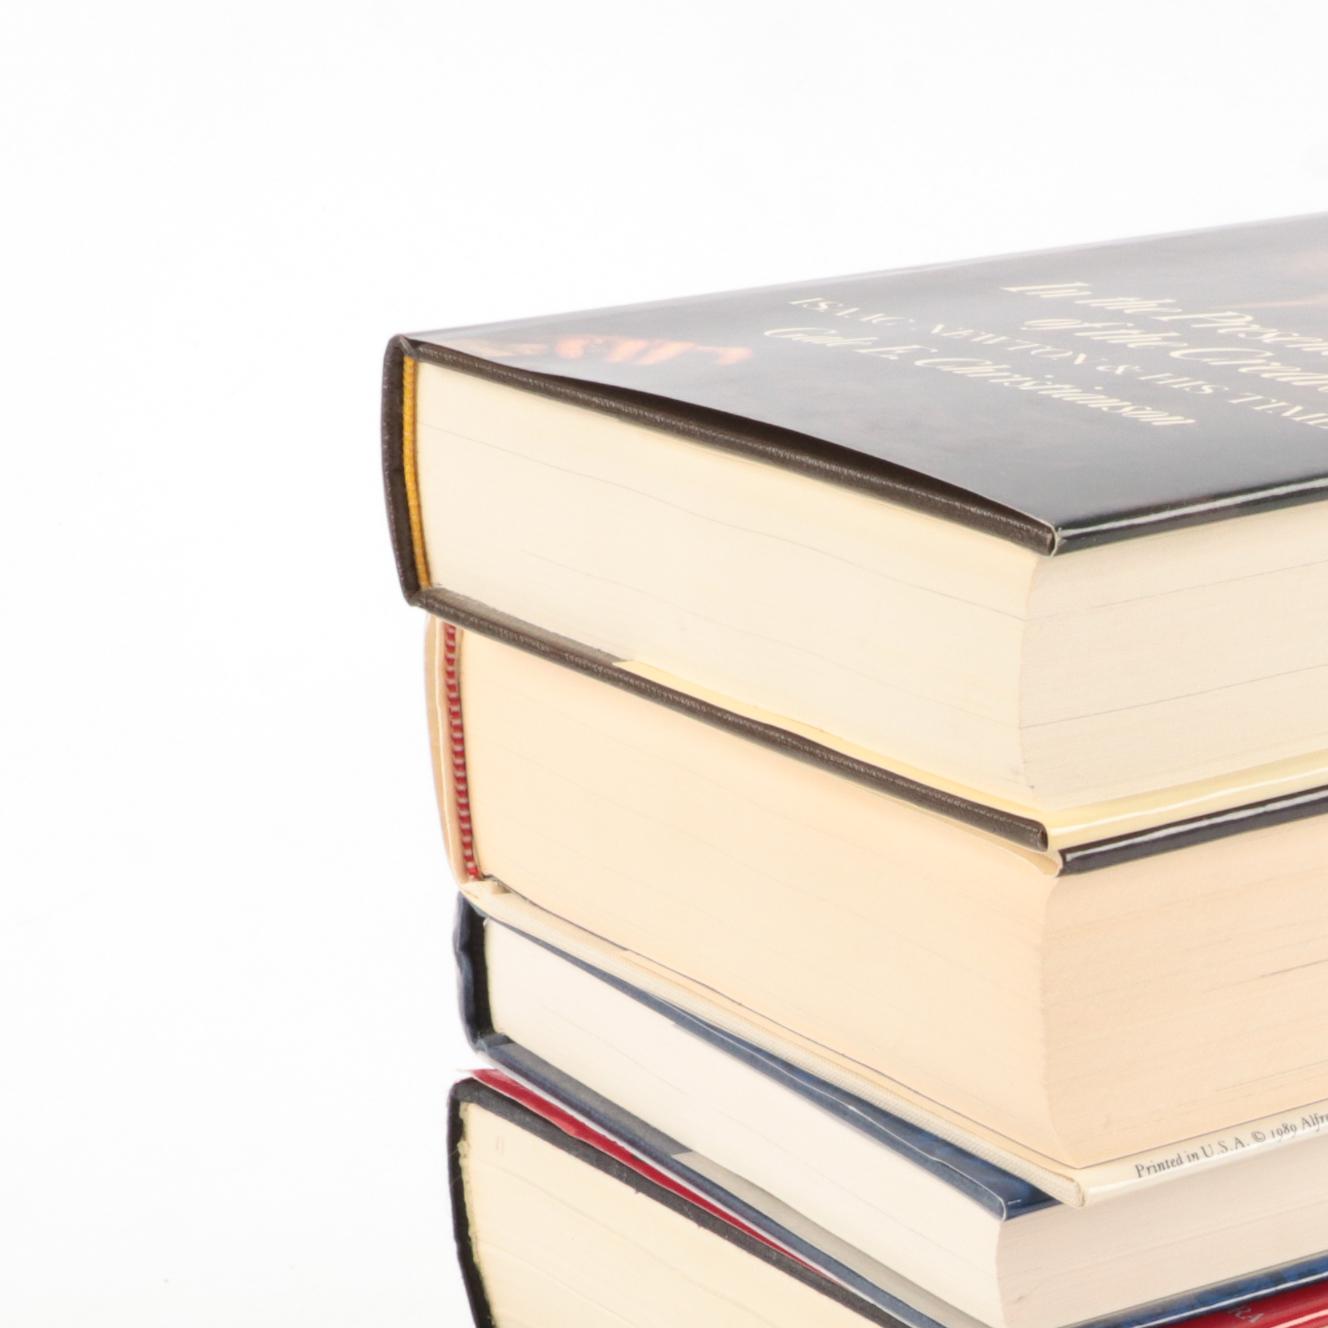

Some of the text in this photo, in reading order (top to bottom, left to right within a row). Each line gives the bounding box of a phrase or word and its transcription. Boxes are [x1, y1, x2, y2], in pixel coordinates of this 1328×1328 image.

[1001, 282, 1092, 298] In
[1074, 297, 1183, 314] the
[789, 296, 916, 330] ISAAC
[931, 323, 1087, 365] NEWTON
[1096, 356, 1142, 376] &
[1138, 371, 1230, 394] HIS
[1021, 318, 1135, 331] of
[1074, 328, 1189, 349] the
[763, 326, 1196, 426] Gale E. Christianson
[1134, 1151, 1184, 1178] Printed
[1185, 1149, 1201, 1163] in
[1200, 1135, 1250, 1158] U.S.A.
[1270, 1121, 1298, 1141] 1989
